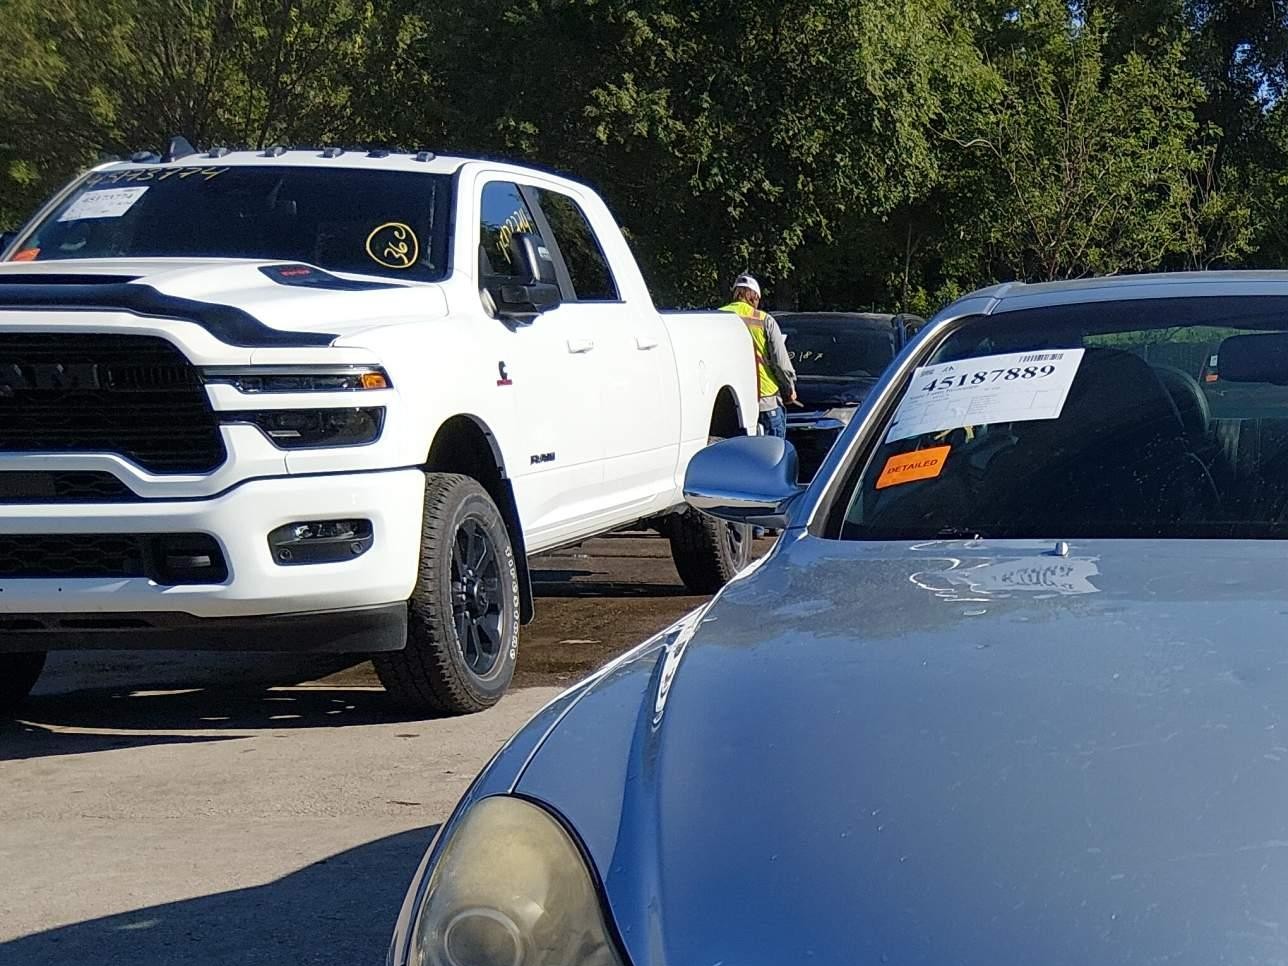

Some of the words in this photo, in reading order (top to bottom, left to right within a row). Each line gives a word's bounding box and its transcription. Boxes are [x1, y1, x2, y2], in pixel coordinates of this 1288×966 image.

[922, 365, 1056, 393] 45187889
[530, 452, 556, 465] RAM
[887, 459, 938, 474] DETAILED
